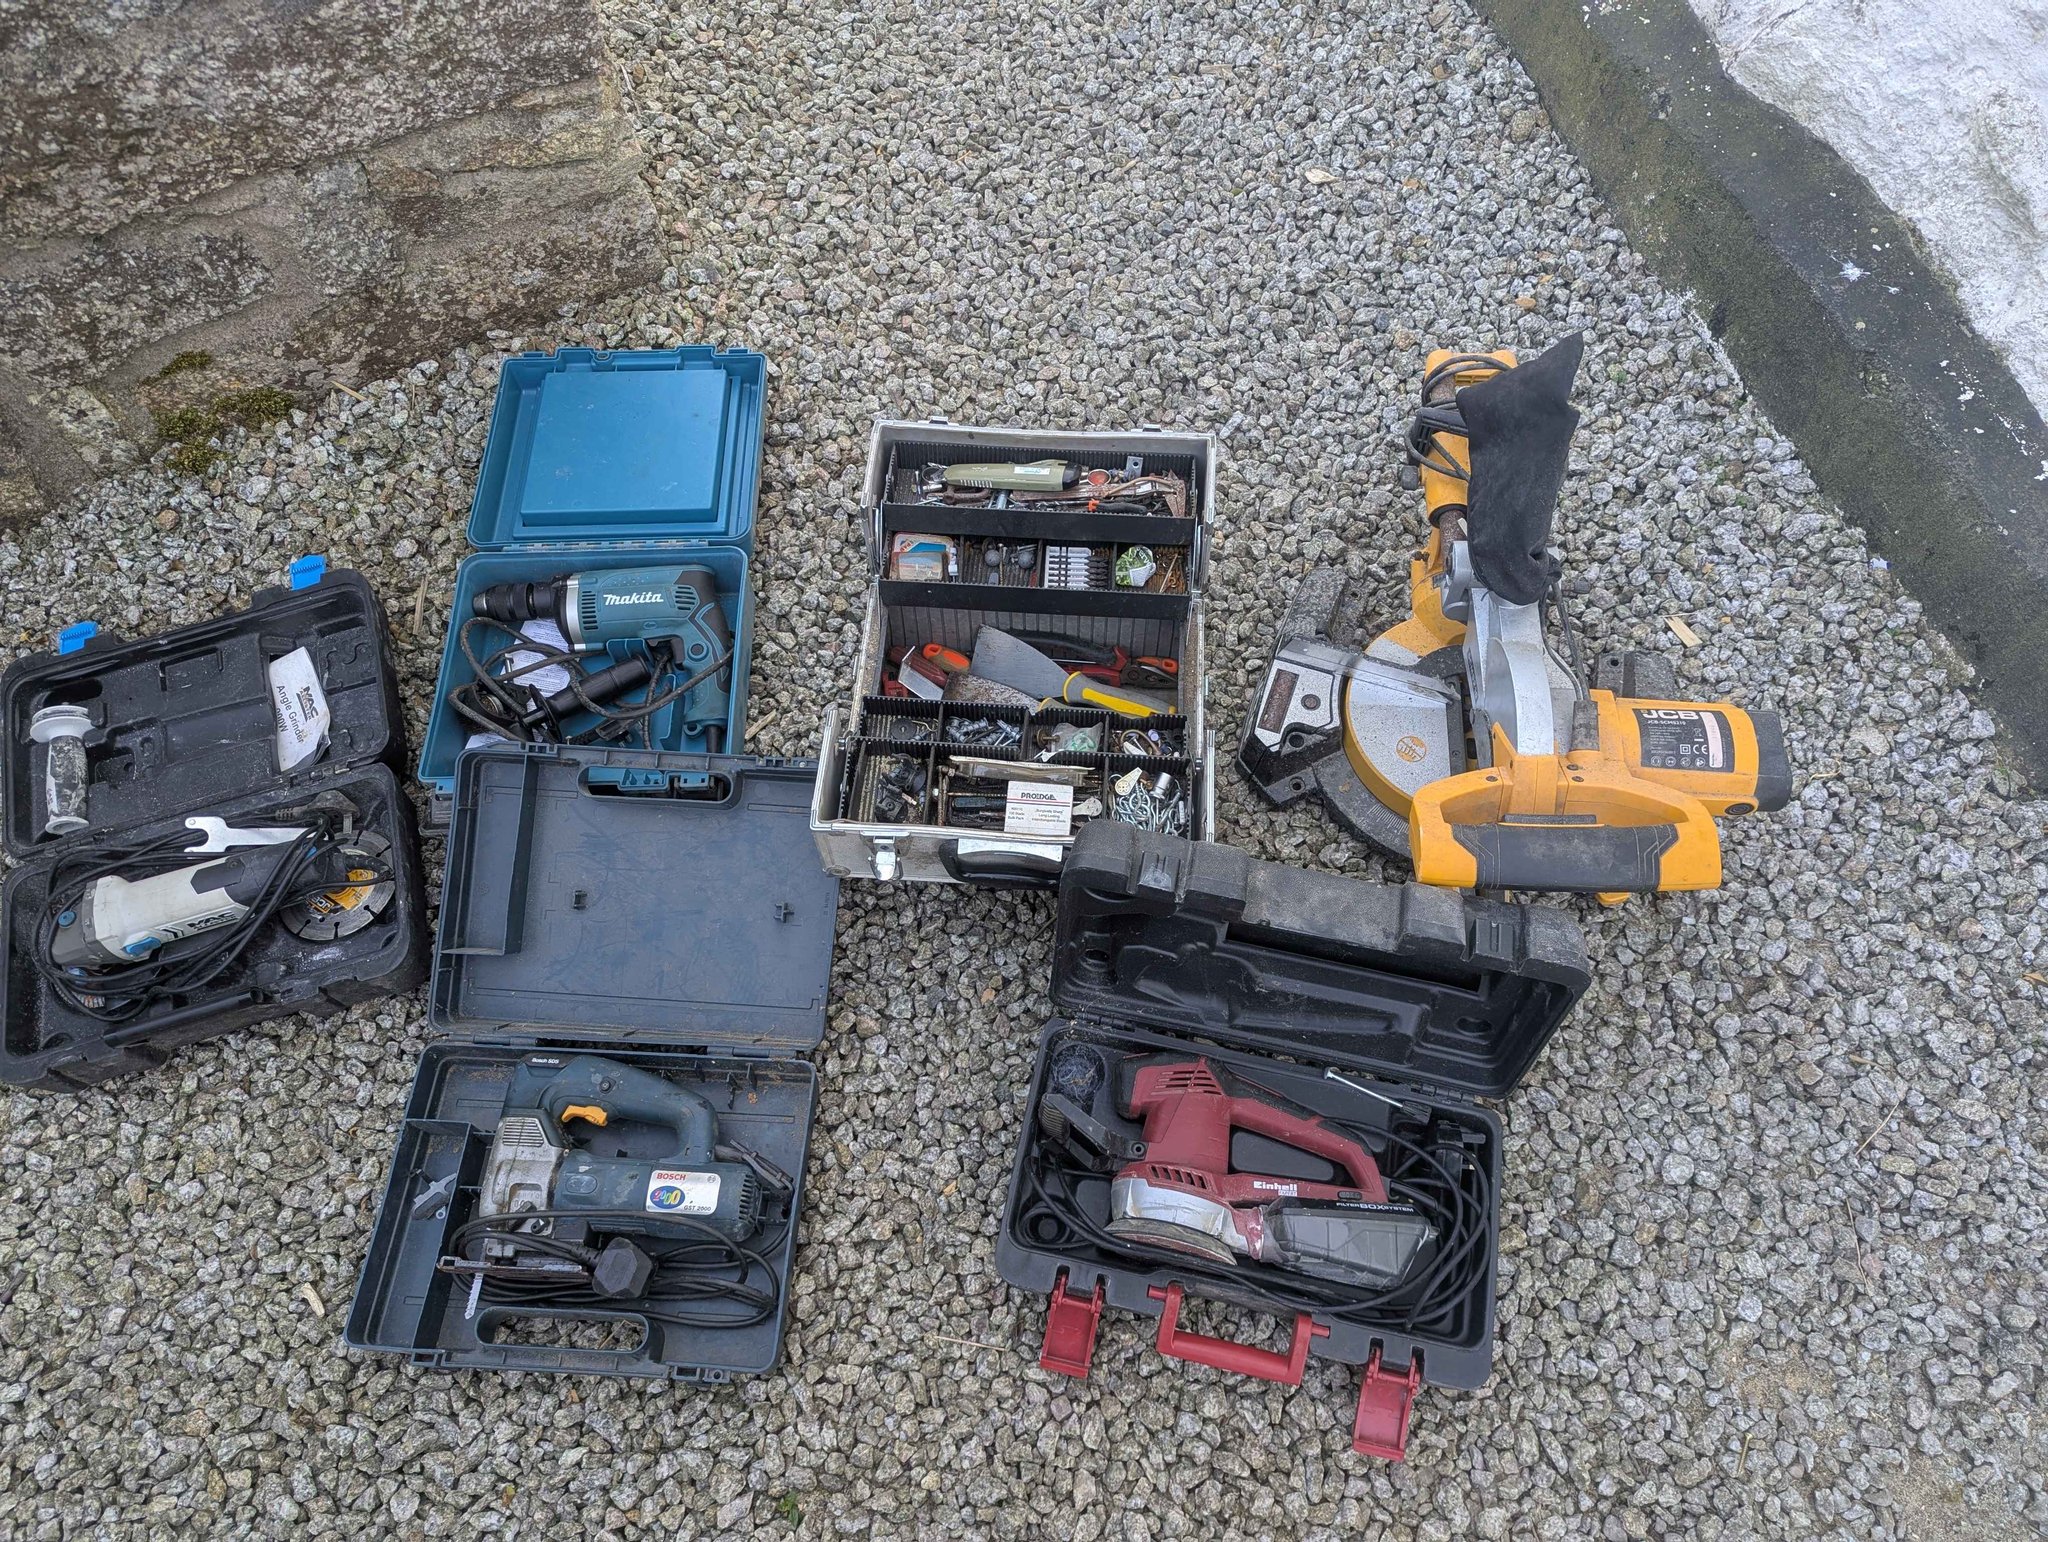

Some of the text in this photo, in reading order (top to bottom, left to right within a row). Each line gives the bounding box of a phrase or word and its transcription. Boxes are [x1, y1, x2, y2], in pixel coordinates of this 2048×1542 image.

[276, 685, 304, 743] Angle Grinder
[1641, 710, 1699, 720] JCB
[656, 1173, 686, 1181] BOSCH
[1253, 1180, 1297, 1191] Einhell
